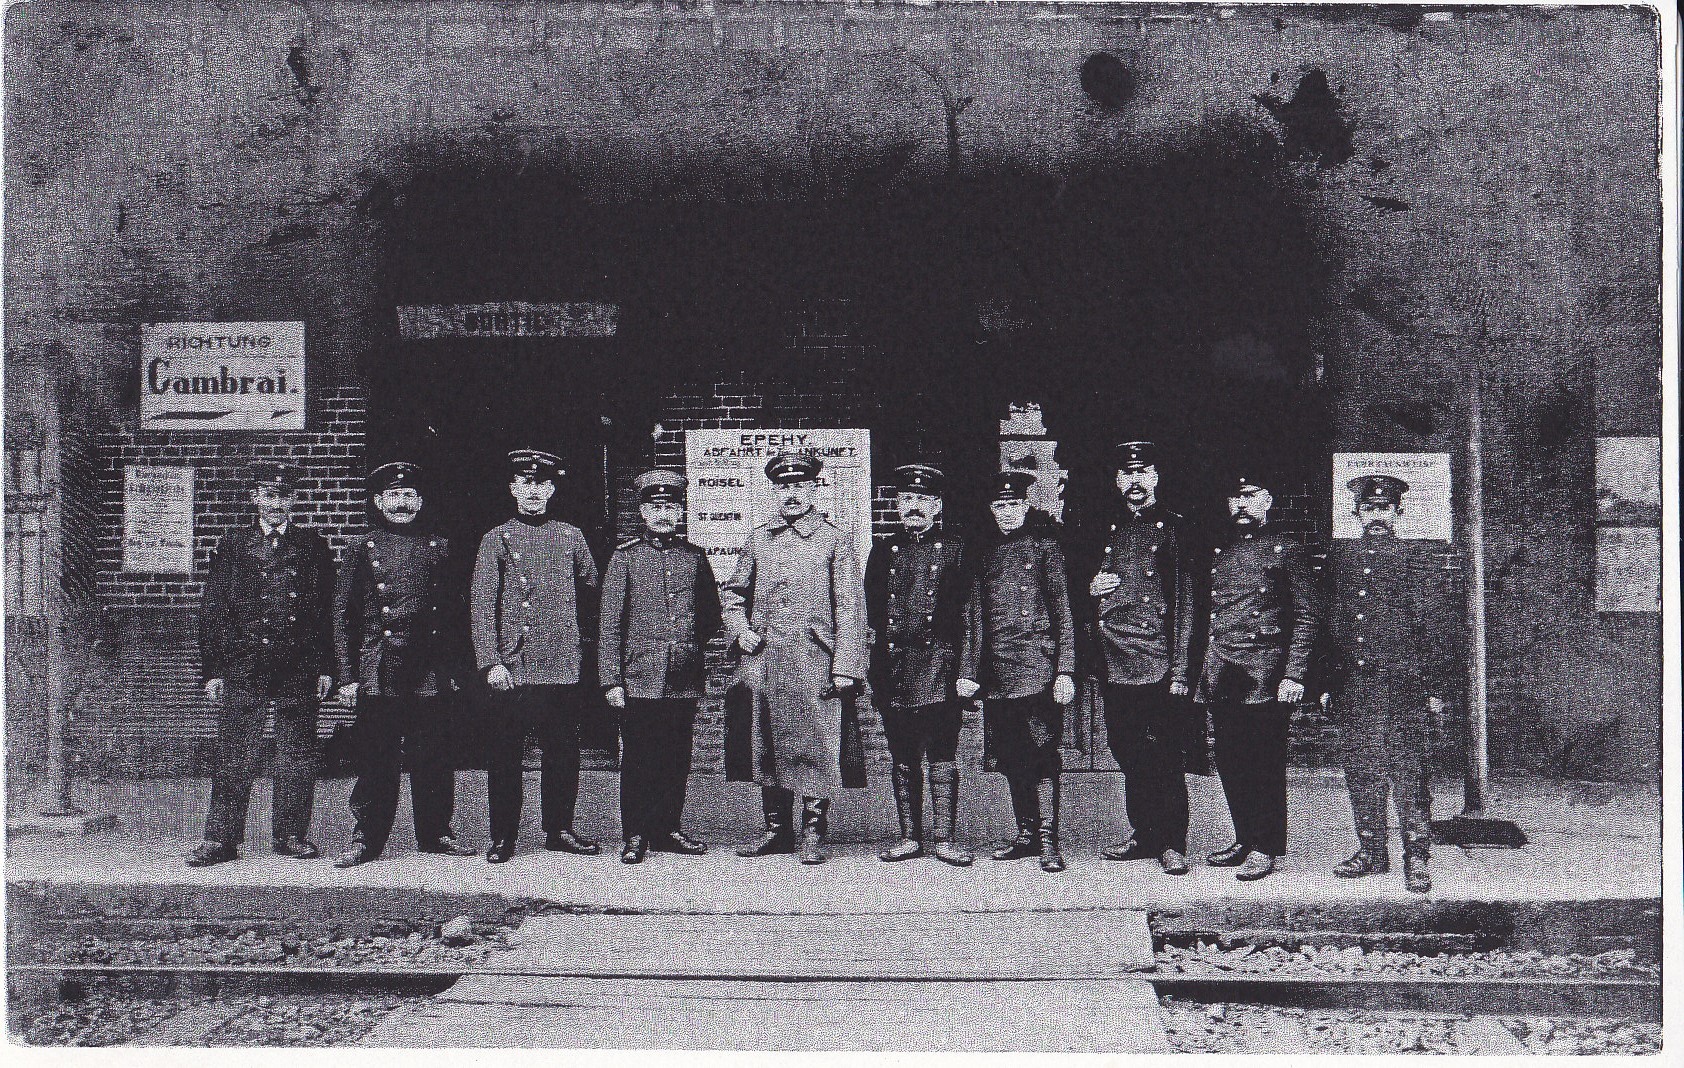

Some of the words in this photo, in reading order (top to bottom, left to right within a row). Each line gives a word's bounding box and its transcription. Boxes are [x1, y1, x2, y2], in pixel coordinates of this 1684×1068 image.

[166, 335, 271, 349] RICHTUNG
[149, 357, 298, 395] Cambrai.
[740, 434, 812, 446] EPEHY.
[698, 477, 745, 488] ROISEL
[707, 547, 743, 556] APAUM
